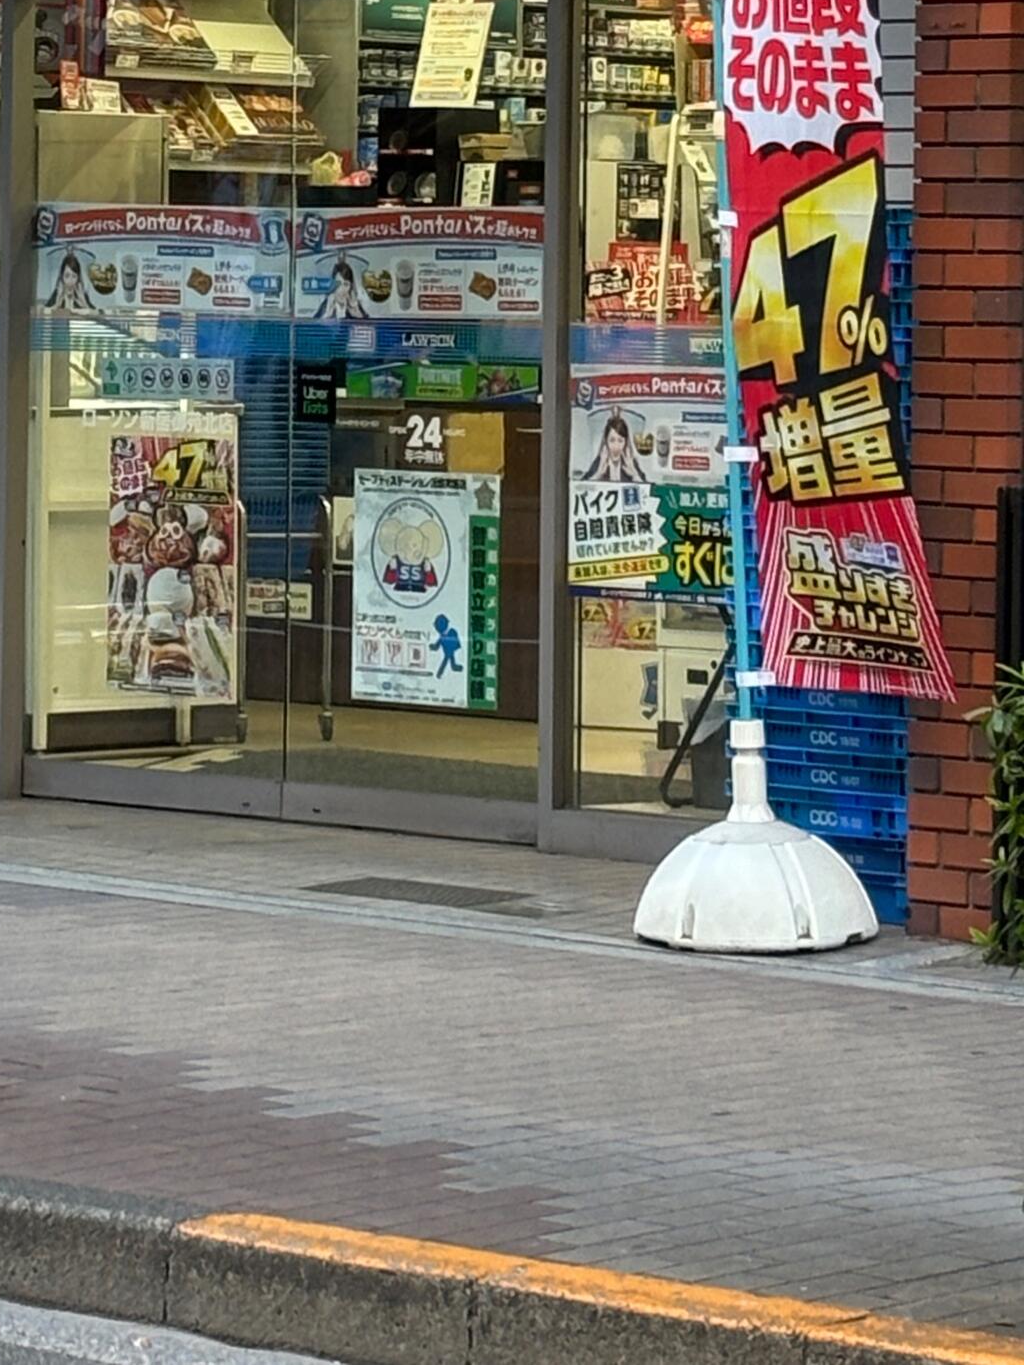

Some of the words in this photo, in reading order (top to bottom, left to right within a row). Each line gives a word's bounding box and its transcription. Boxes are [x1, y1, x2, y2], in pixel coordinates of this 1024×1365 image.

[727, 35, 875, 121] そのまま
[732, 158, 889, 385] 47%
[406, 414, 443, 448] 24
[761, 372, 906, 501] 増量
[152, 441, 208, 488] 47
[574, 489, 619, 516] バイク
[399, 565, 422, 581] SS
[813, 598, 919, 640] チャレンジ
[809, 730, 838, 746] CDC
[810, 769, 838, 784] CDC
